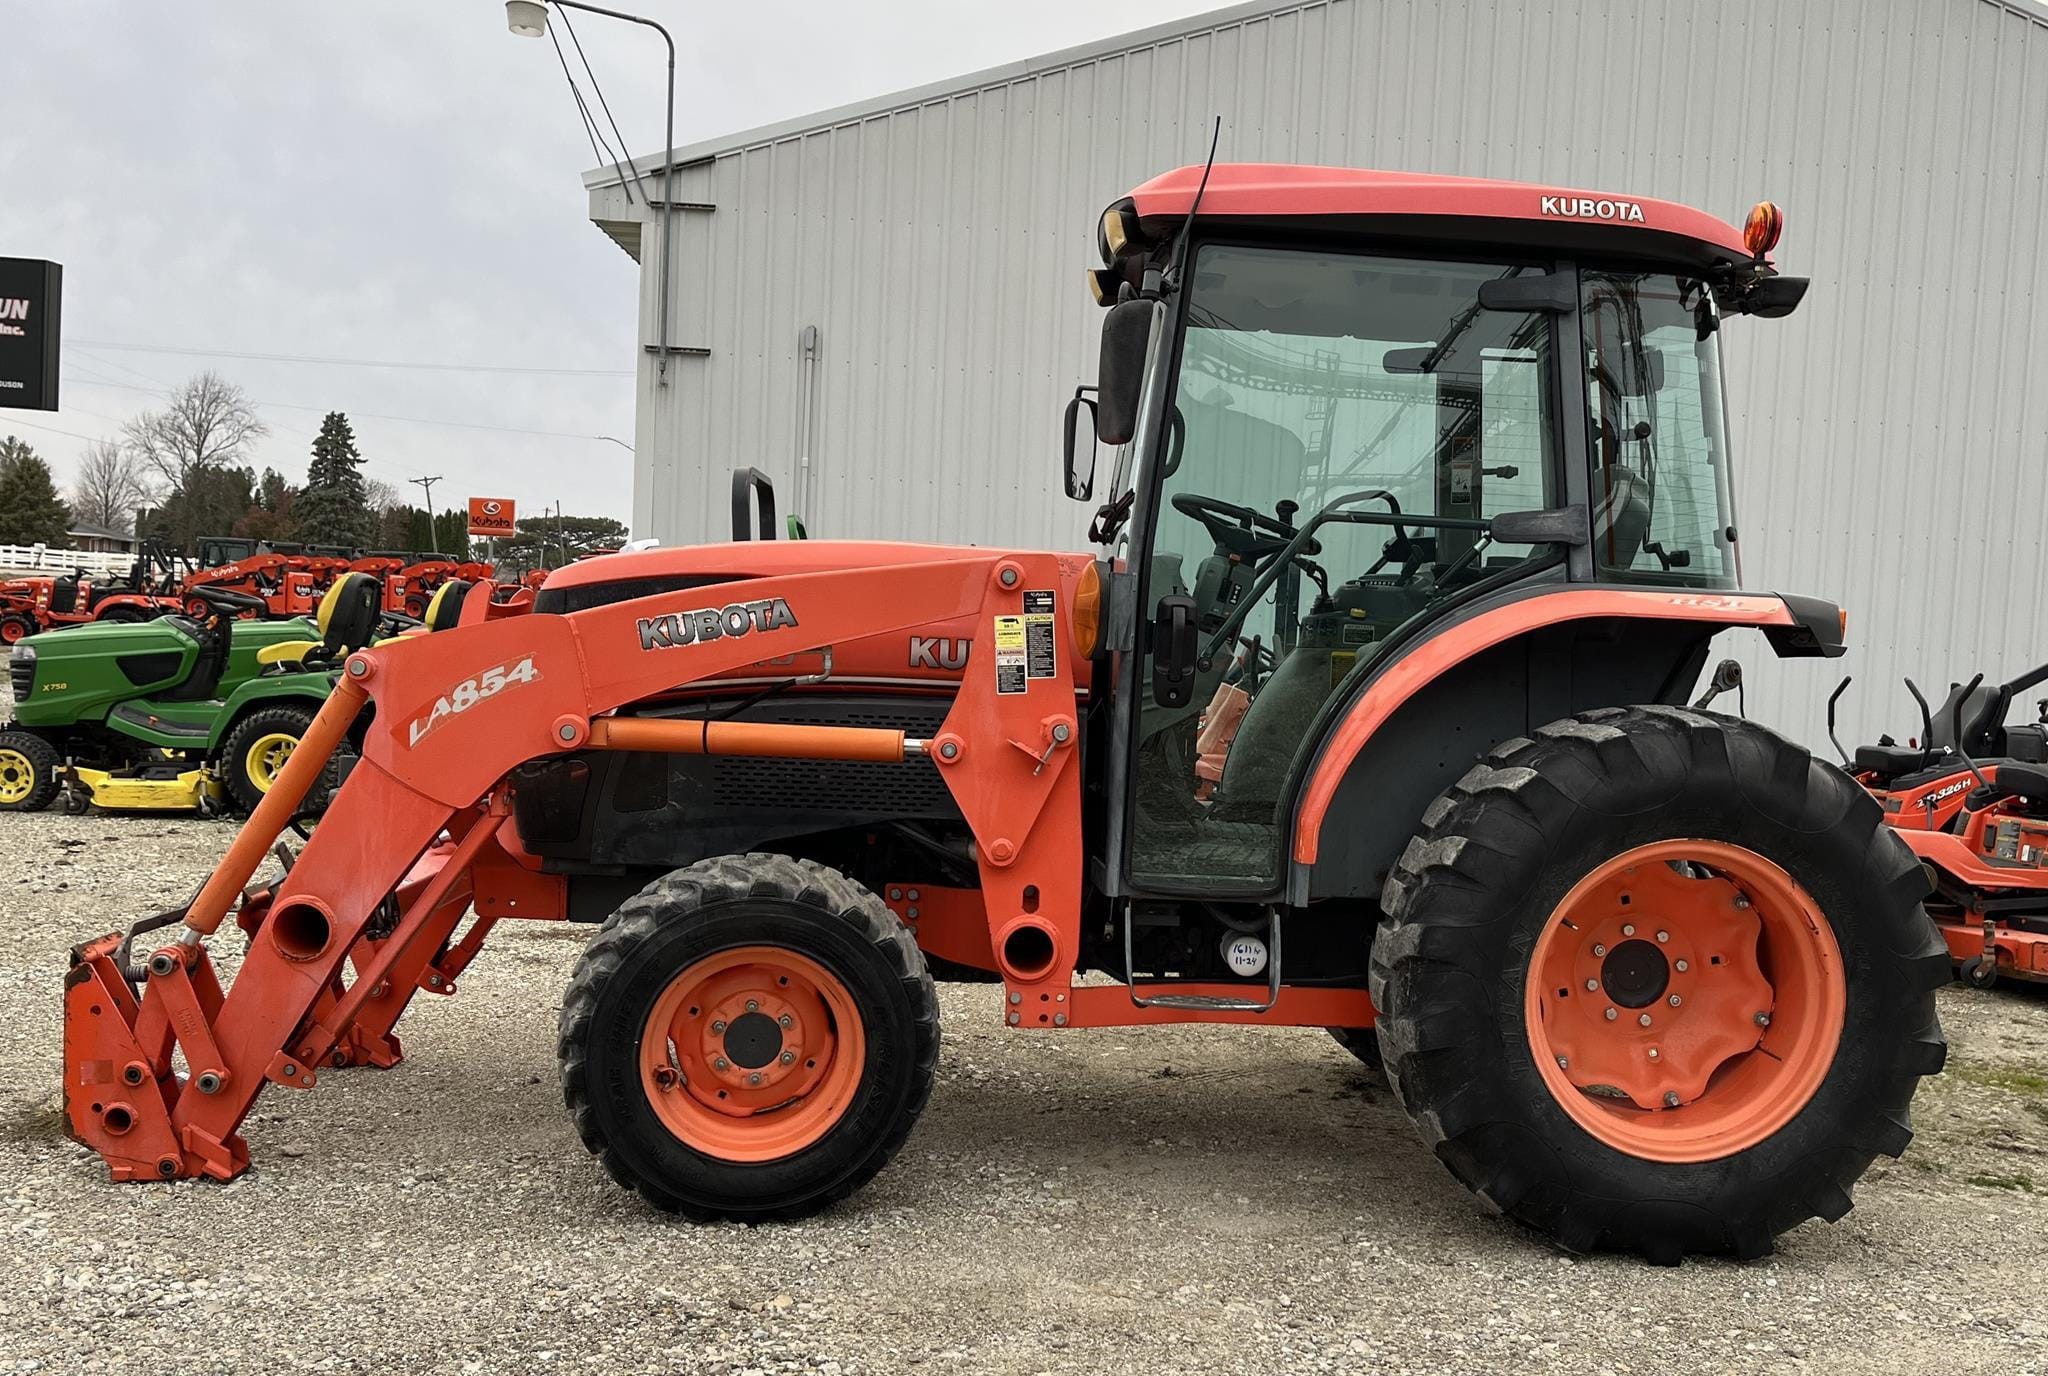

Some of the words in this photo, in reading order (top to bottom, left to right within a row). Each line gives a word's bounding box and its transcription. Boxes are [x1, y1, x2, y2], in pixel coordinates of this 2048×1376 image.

[1540, 196, 1645, 223] KUBOTA
[472, 516, 510, 527] Kubota
[638, 598, 799, 650] KUBOTA
[909, 636, 974, 671] KU
[42, 682, 68, 692] X758
[409, 659, 539, 747] LA854
[1233, 943, 1252, 954] 1611
[1235, 956, 1258, 967] 11-24
